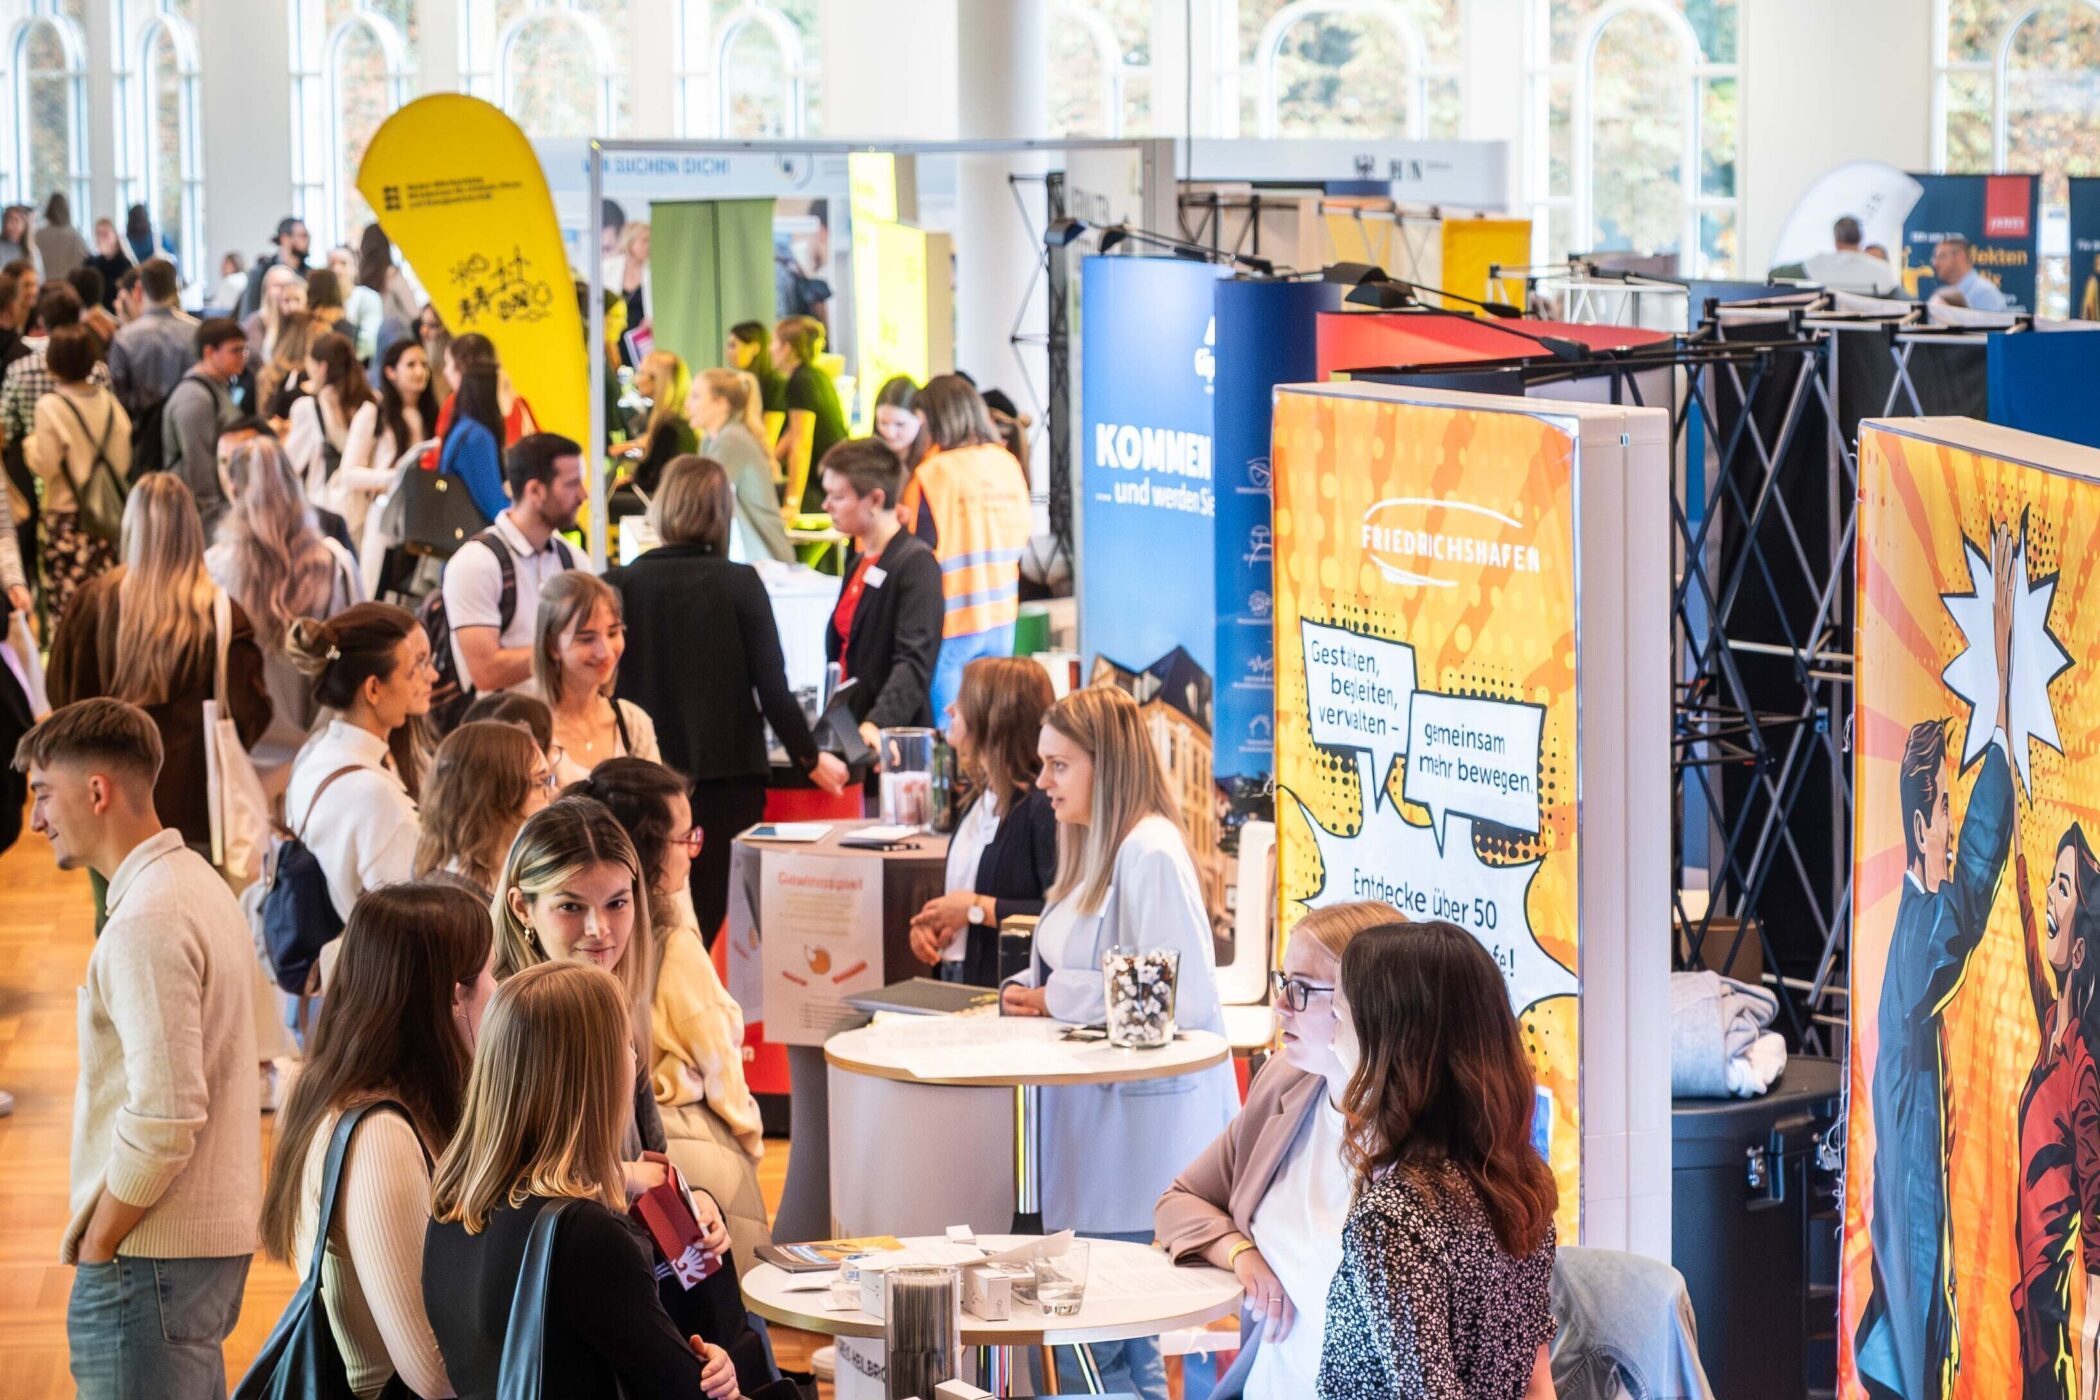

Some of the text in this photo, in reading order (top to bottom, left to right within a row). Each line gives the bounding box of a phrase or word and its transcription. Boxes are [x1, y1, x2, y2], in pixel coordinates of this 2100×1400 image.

[616, 158, 679, 174] SUCHEN
[1970, 245, 2028, 266] fekten
[1096, 423, 1212, 480] KOMMEN
[1114, 477, 1150, 506] und
[1151, 482, 1200, 513] werden
[1362, 524, 1540, 573] FRIEDRICHSHAFEN
[1424, 722, 1505, 755] gemeinsam
[1419, 753, 1534, 795] mehr bewegen.
[1354, 867, 1498, 930] Entdecke über 50
